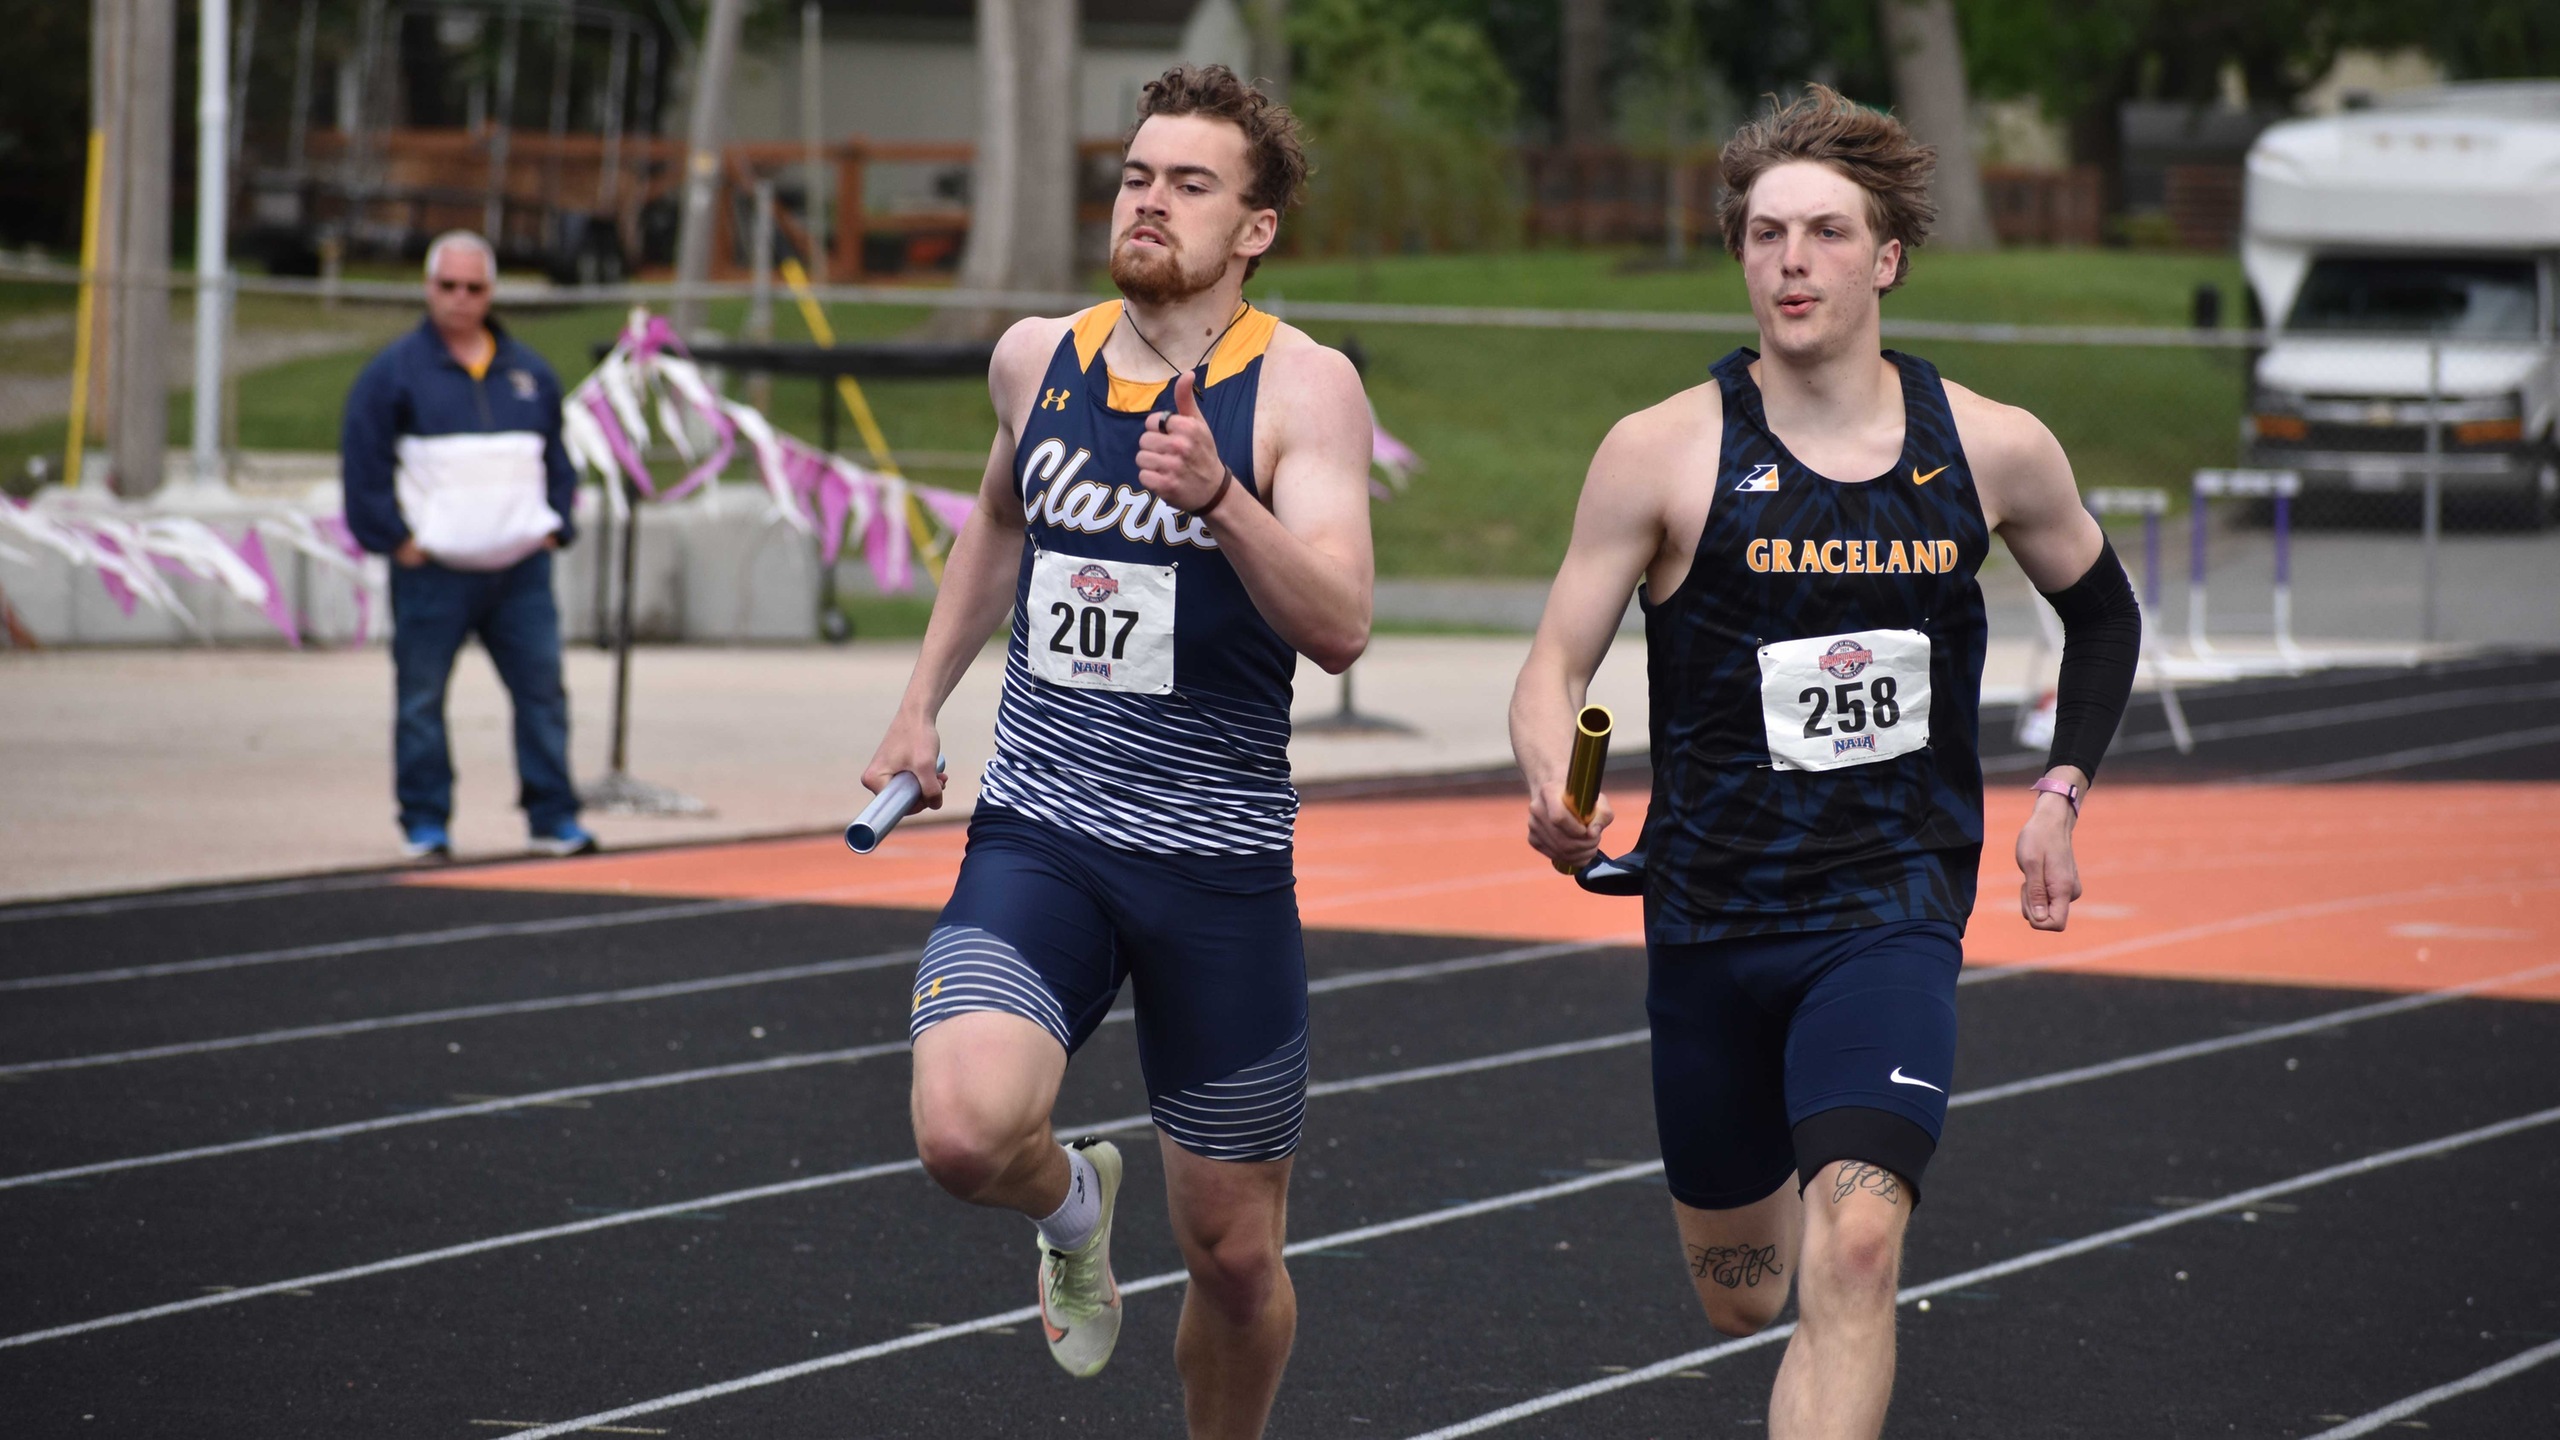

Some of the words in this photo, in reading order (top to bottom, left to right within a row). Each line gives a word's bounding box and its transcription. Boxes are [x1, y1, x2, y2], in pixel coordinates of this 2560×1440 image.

[1746, 538, 1958, 574] GRACELAND
[1049, 601, 1139, 660] 207
[1073, 661, 1109, 678] NAIA
[1819, 649, 1873, 671] CHAMPIONSHIPS
[1798, 676, 1901, 740] 258
[1834, 736, 1874, 755] NAIA
[1688, 1243, 1784, 1289] FEAR
